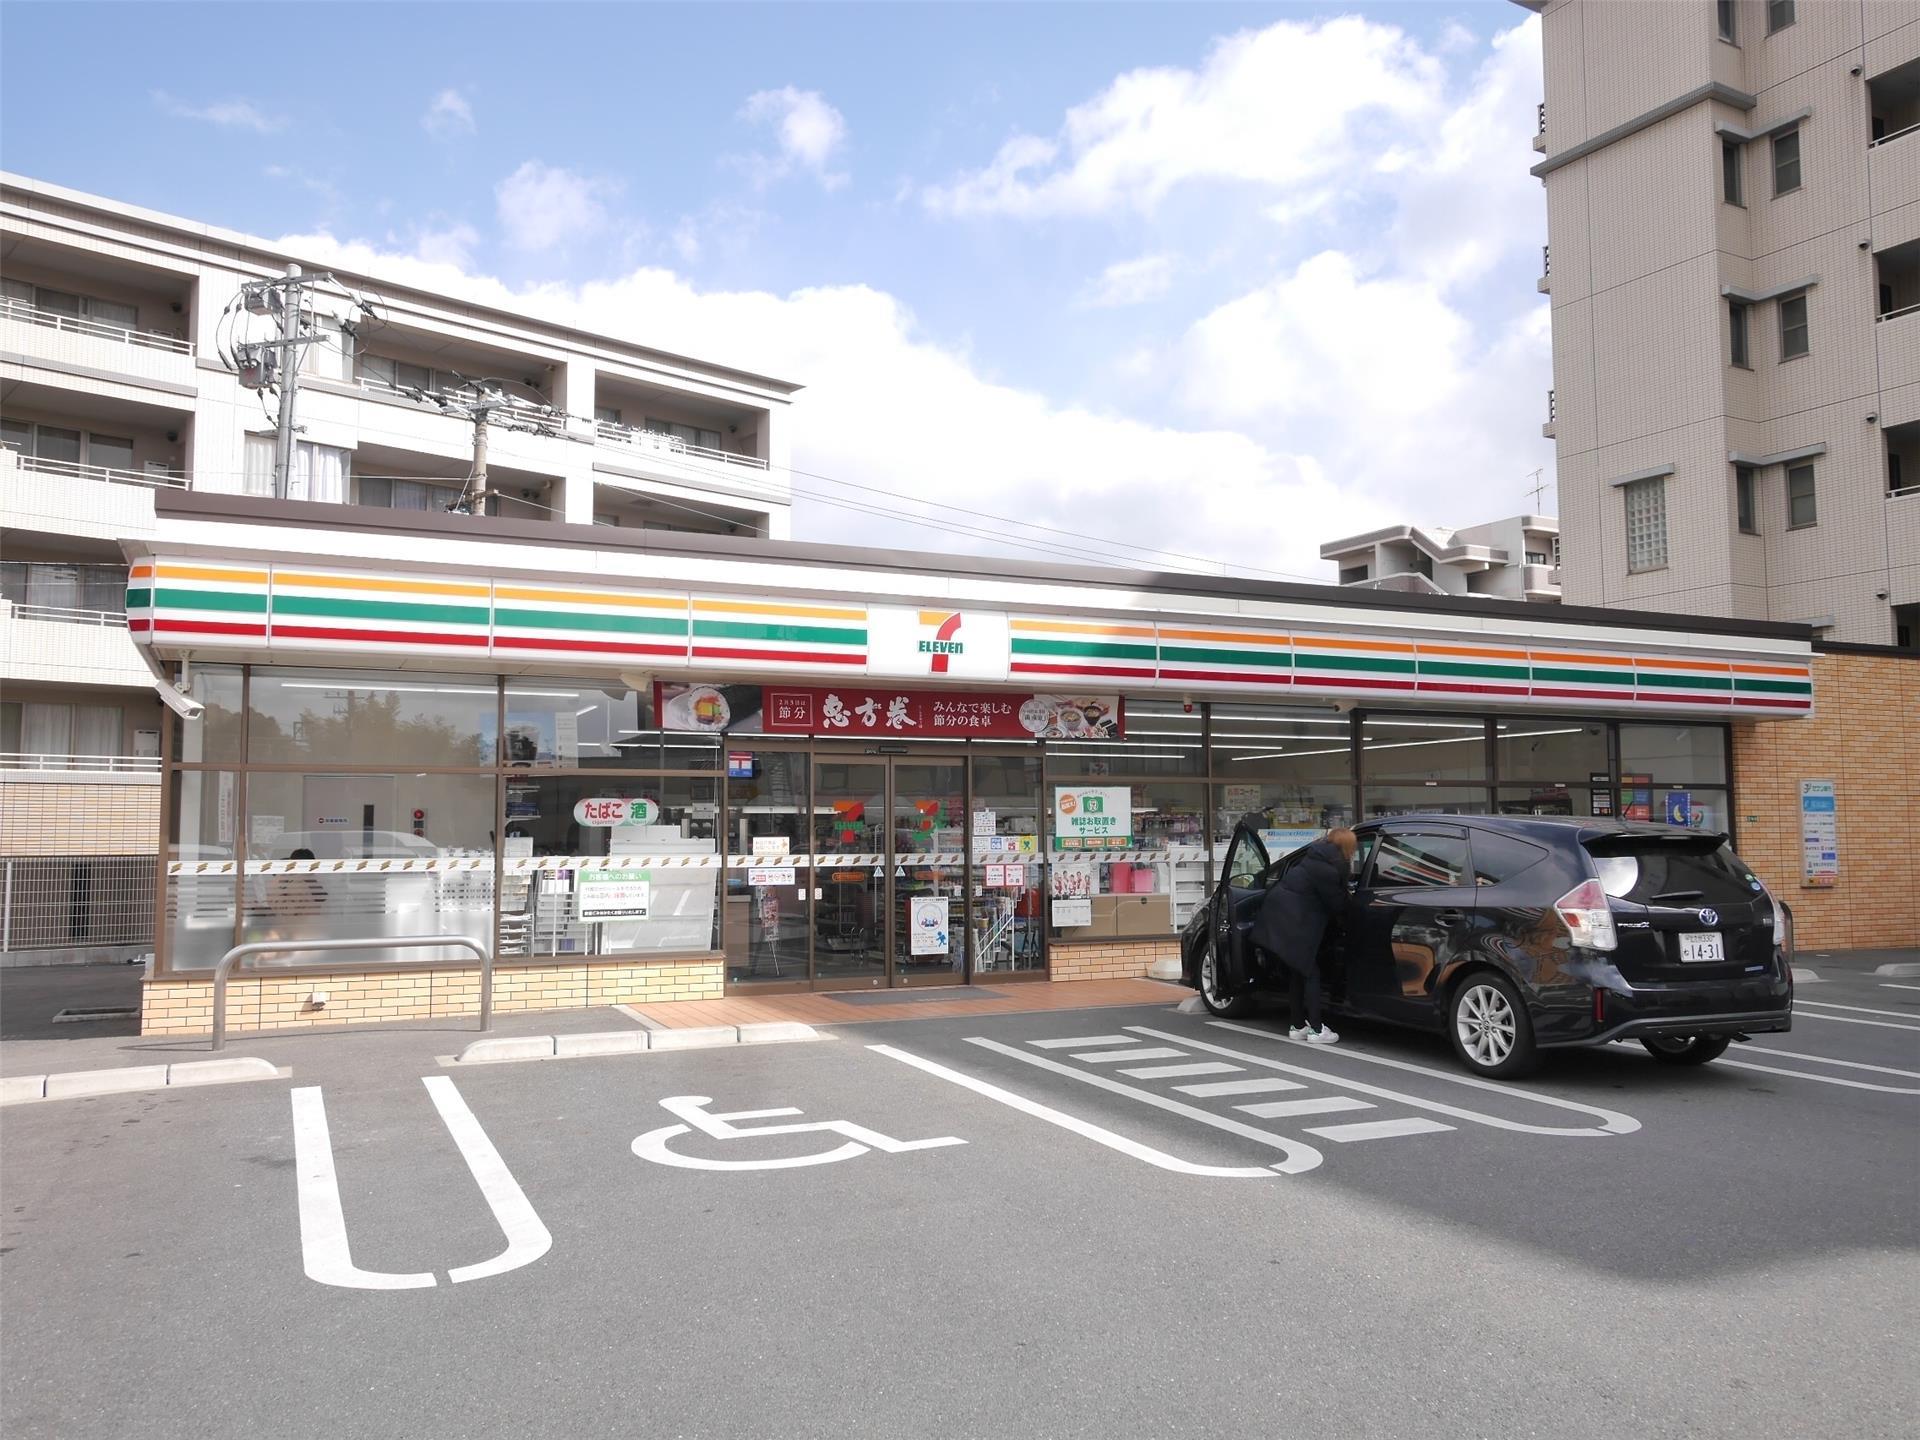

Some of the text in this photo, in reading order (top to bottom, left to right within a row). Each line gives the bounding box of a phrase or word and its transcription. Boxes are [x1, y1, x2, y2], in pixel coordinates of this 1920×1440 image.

[778, 706, 806, 720] 節分
[932, 701, 1012, 715] みんなで楽しむ
[933, 714, 992, 728] 節分の食卓
[584, 801, 647, 819] たばこ 酒
[1071, 816, 1117, 826] 雑誌お取置き
[1079, 826, 1109, 835] サービス
